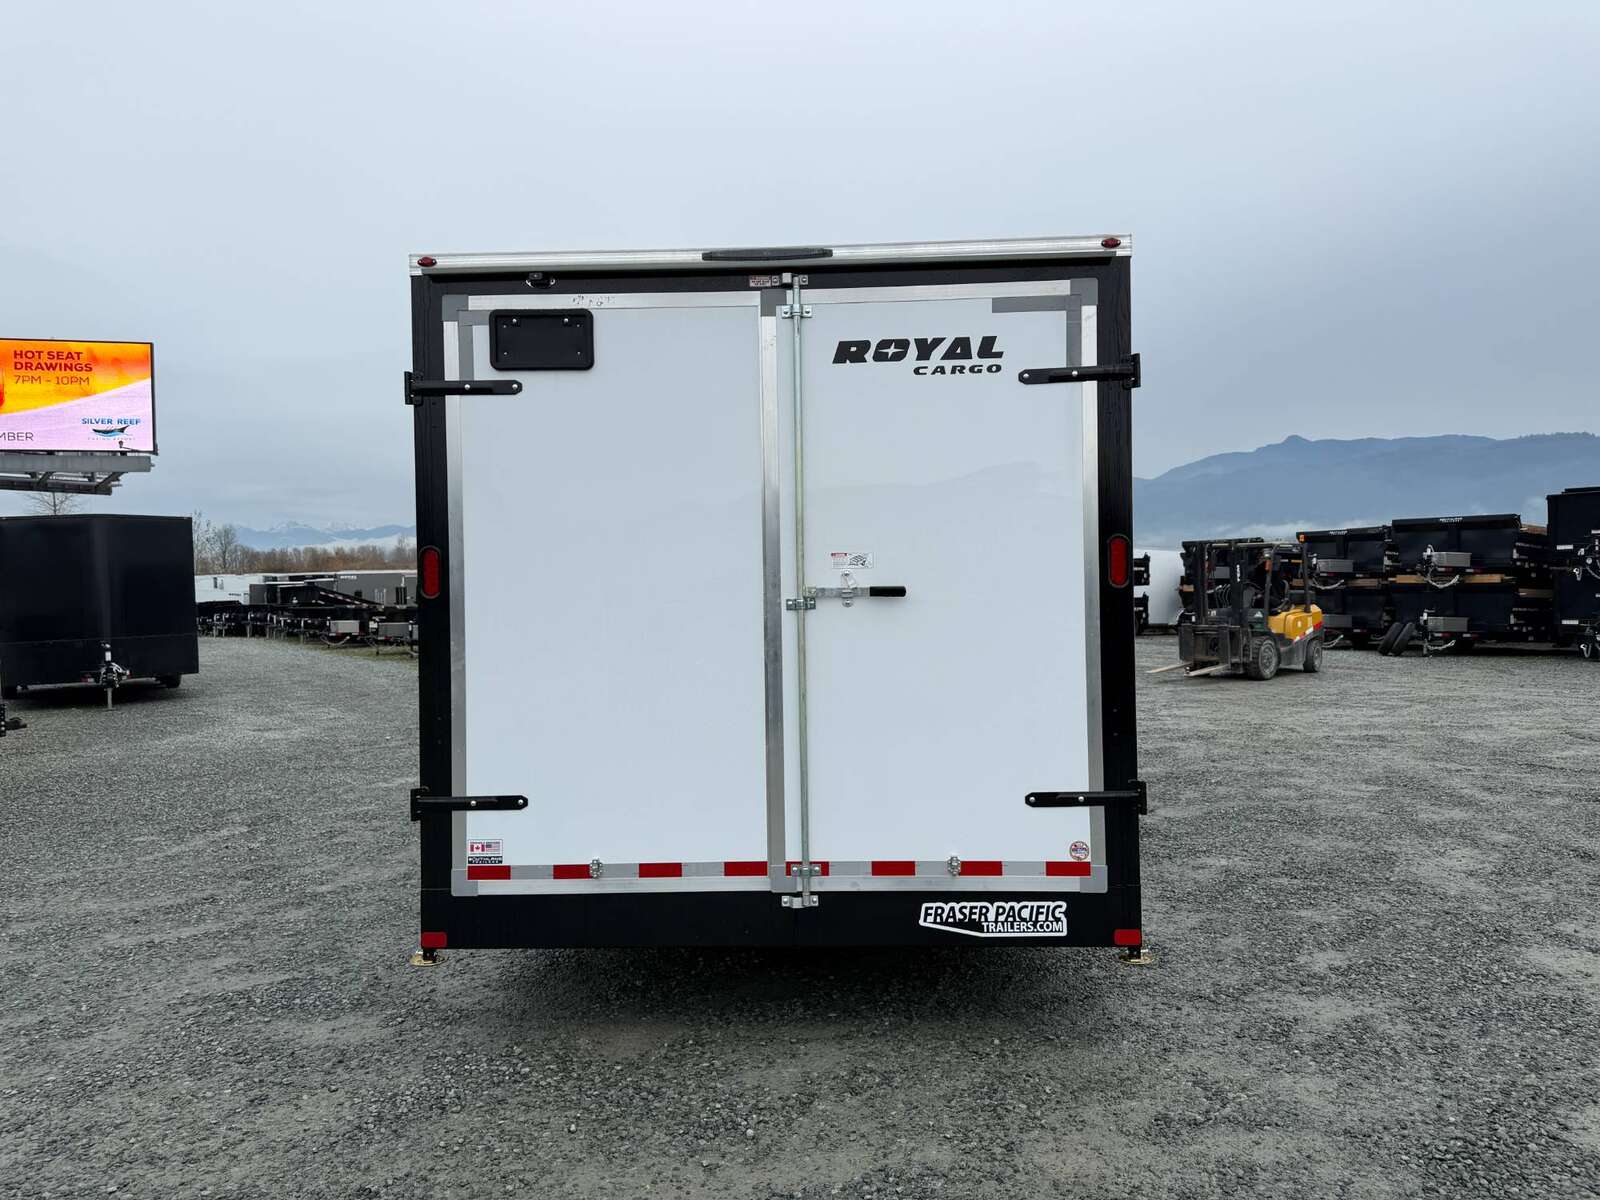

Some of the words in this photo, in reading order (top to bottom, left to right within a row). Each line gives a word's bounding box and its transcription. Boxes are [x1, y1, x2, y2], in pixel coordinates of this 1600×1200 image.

[13, 350, 44, 360] HOT
[47, 351, 83, 361] SEAT
[832, 335, 1004, 364] ROYAL
[14, 361, 93, 372] DRAWINGS
[913, 364, 1002, 376] CARGO
[14, 374, 42, 385] 7PM
[56, 375, 90, 386] 10PM
[923, 904, 990, 923] FRASER
[994, 903, 1064, 922] PACIFIC
[982, 921, 1063, 933] TRAILERS.COM
